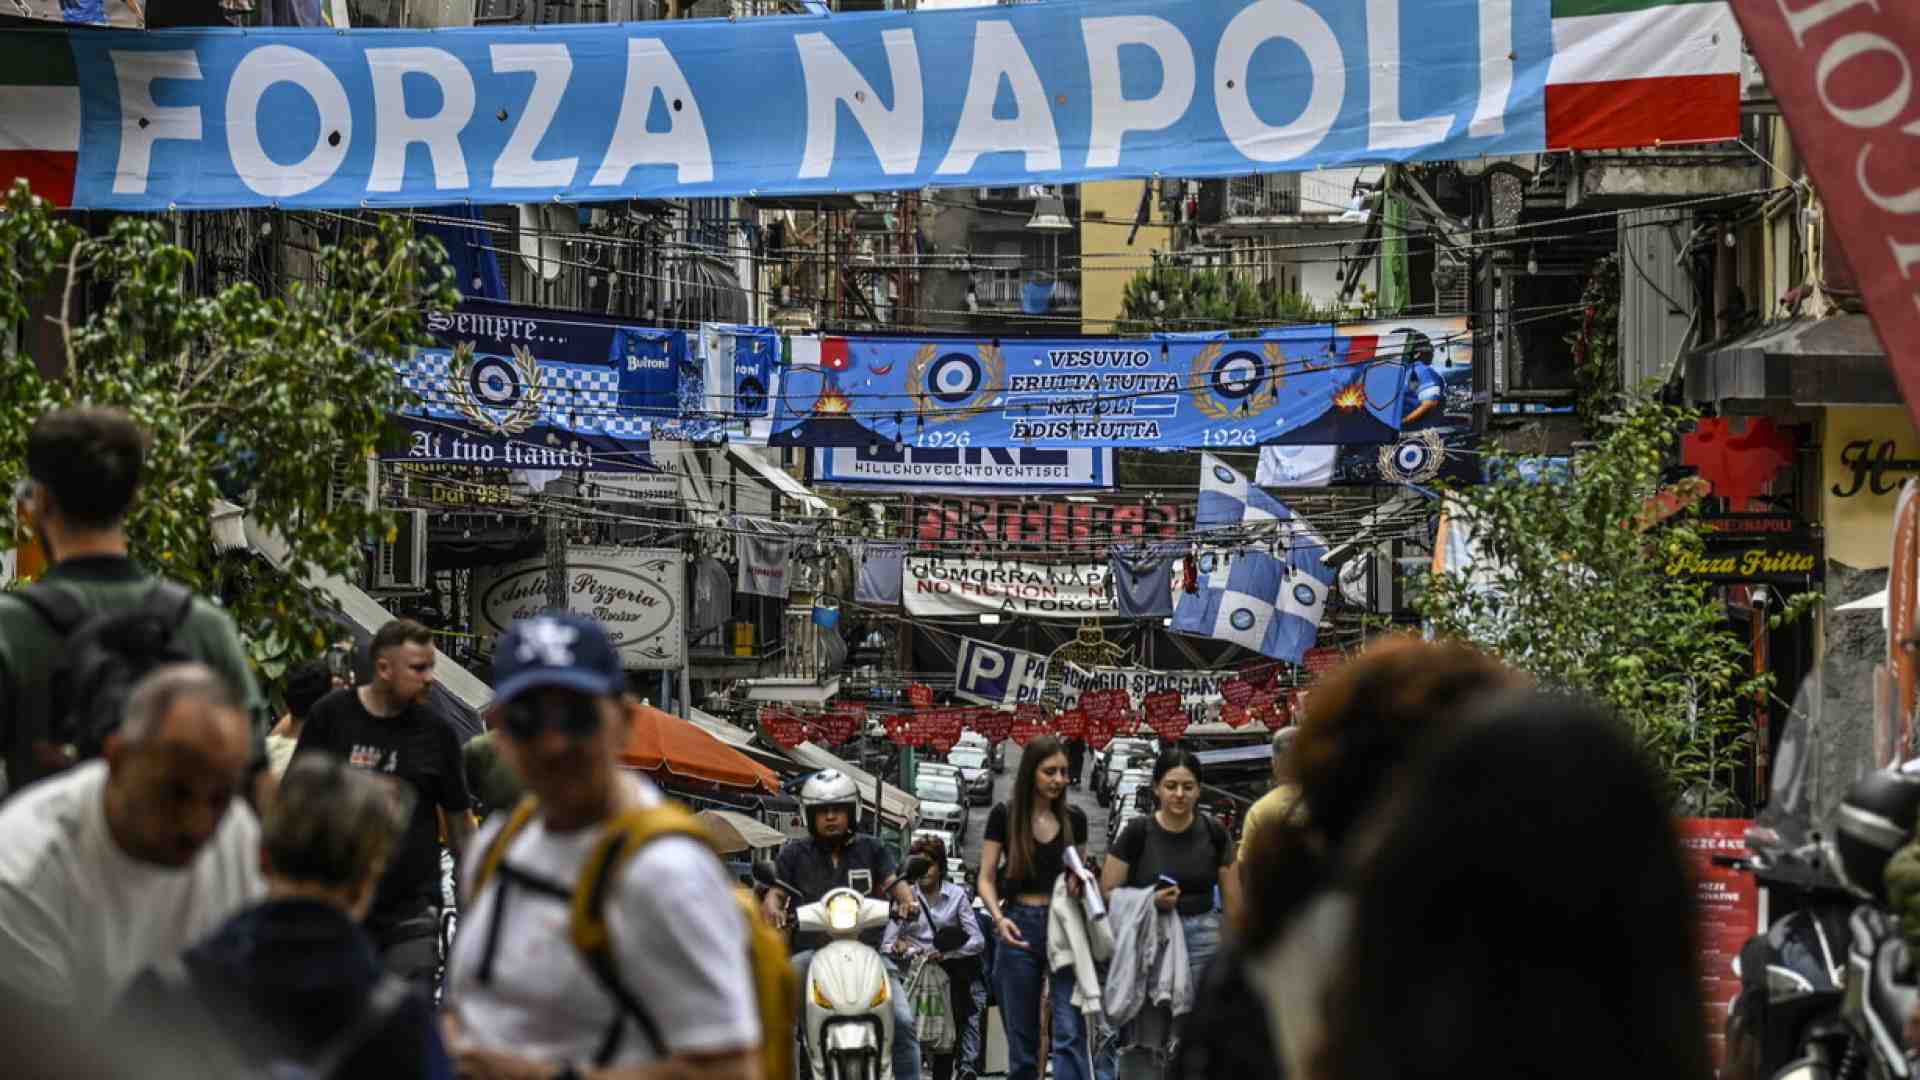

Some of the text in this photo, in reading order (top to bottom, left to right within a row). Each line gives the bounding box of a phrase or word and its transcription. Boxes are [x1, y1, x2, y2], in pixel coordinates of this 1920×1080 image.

[110, 0, 1514, 197] FORZA NAPOLI
[1049, 350, 1150, 368] VESUVIO
[1010, 374, 1181, 393] ERUTTA TUTTA
[1047, 398, 1135, 416] NAPOLI
[916, 431, 970, 447] 1926
[1202, 429, 1257, 447] 1926
[452, 440, 495, 463] tuo
[1665, 548, 1815, 576] Pzza Fritta
[571, 572, 660, 608] Pizzeria
[917, 580, 950, 594] NO
[965, 646, 1006, 698] P
